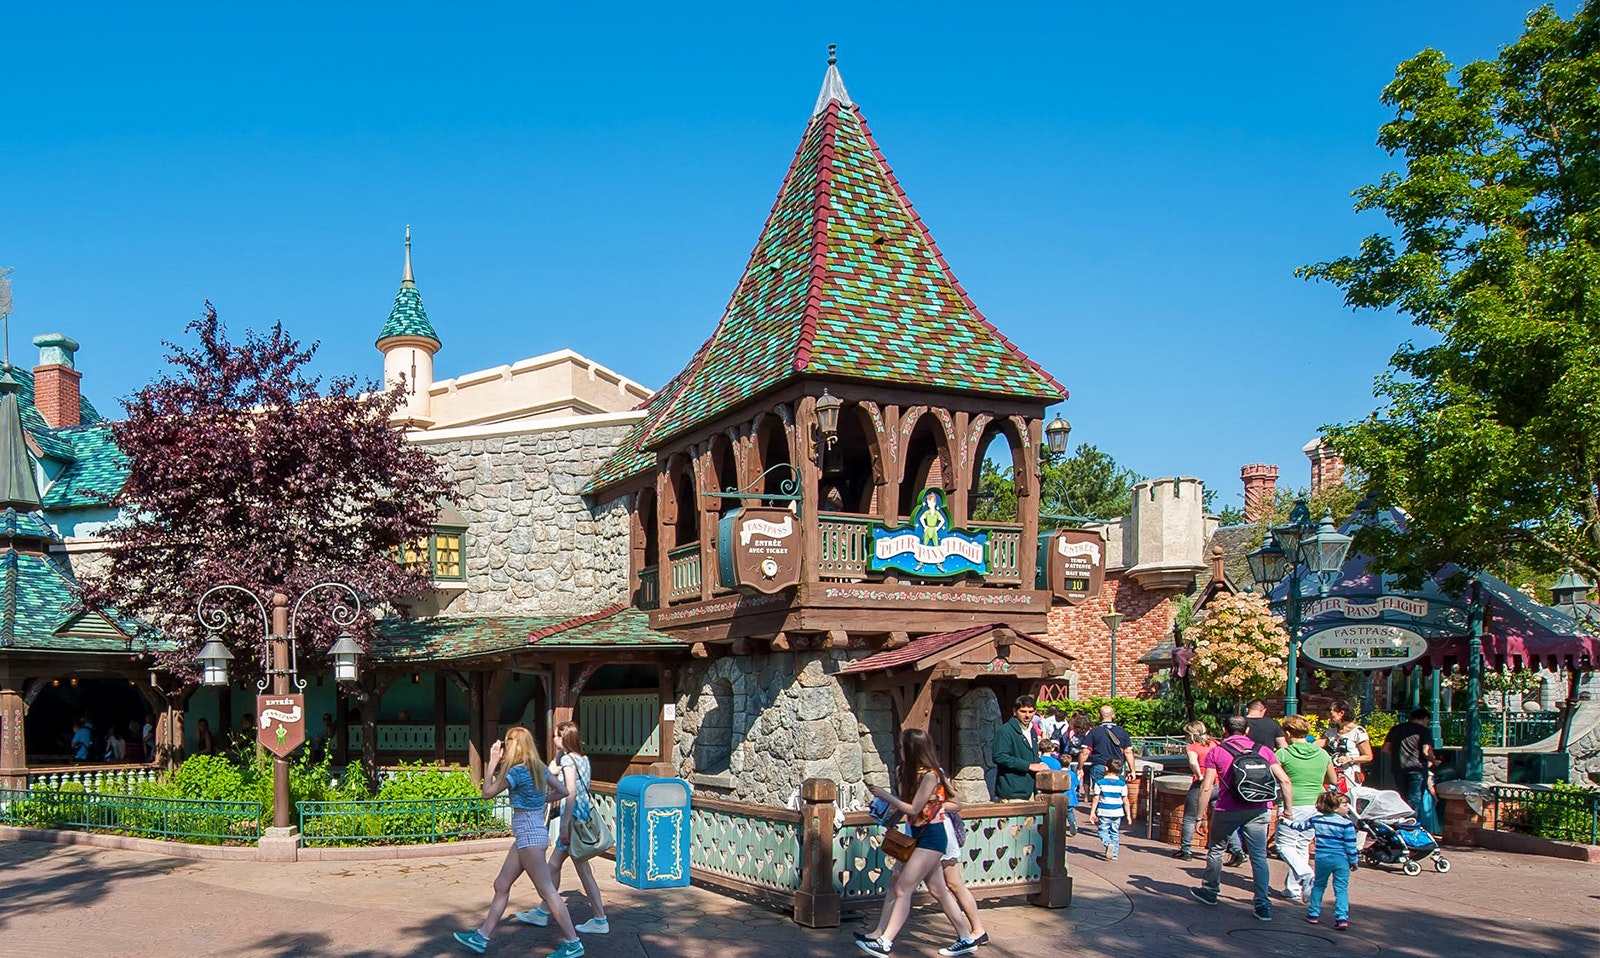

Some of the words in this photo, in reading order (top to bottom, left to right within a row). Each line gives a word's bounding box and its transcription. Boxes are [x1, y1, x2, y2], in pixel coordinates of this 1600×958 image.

[747, 522, 788, 535] FASTPASS
[754, 539, 782, 547] ENTRÉE
[880, 537, 915, 556] PETER
[943, 540, 980, 561] FLIGHT
[1072, 580, 1083, 591] 10
[1380, 598, 1425, 616] FLIGHT
[1334, 627, 1397, 638] FASTPASS
[1343, 638, 1386, 646] TICKETS
[265, 697, 295, 706] ENTRÉE
